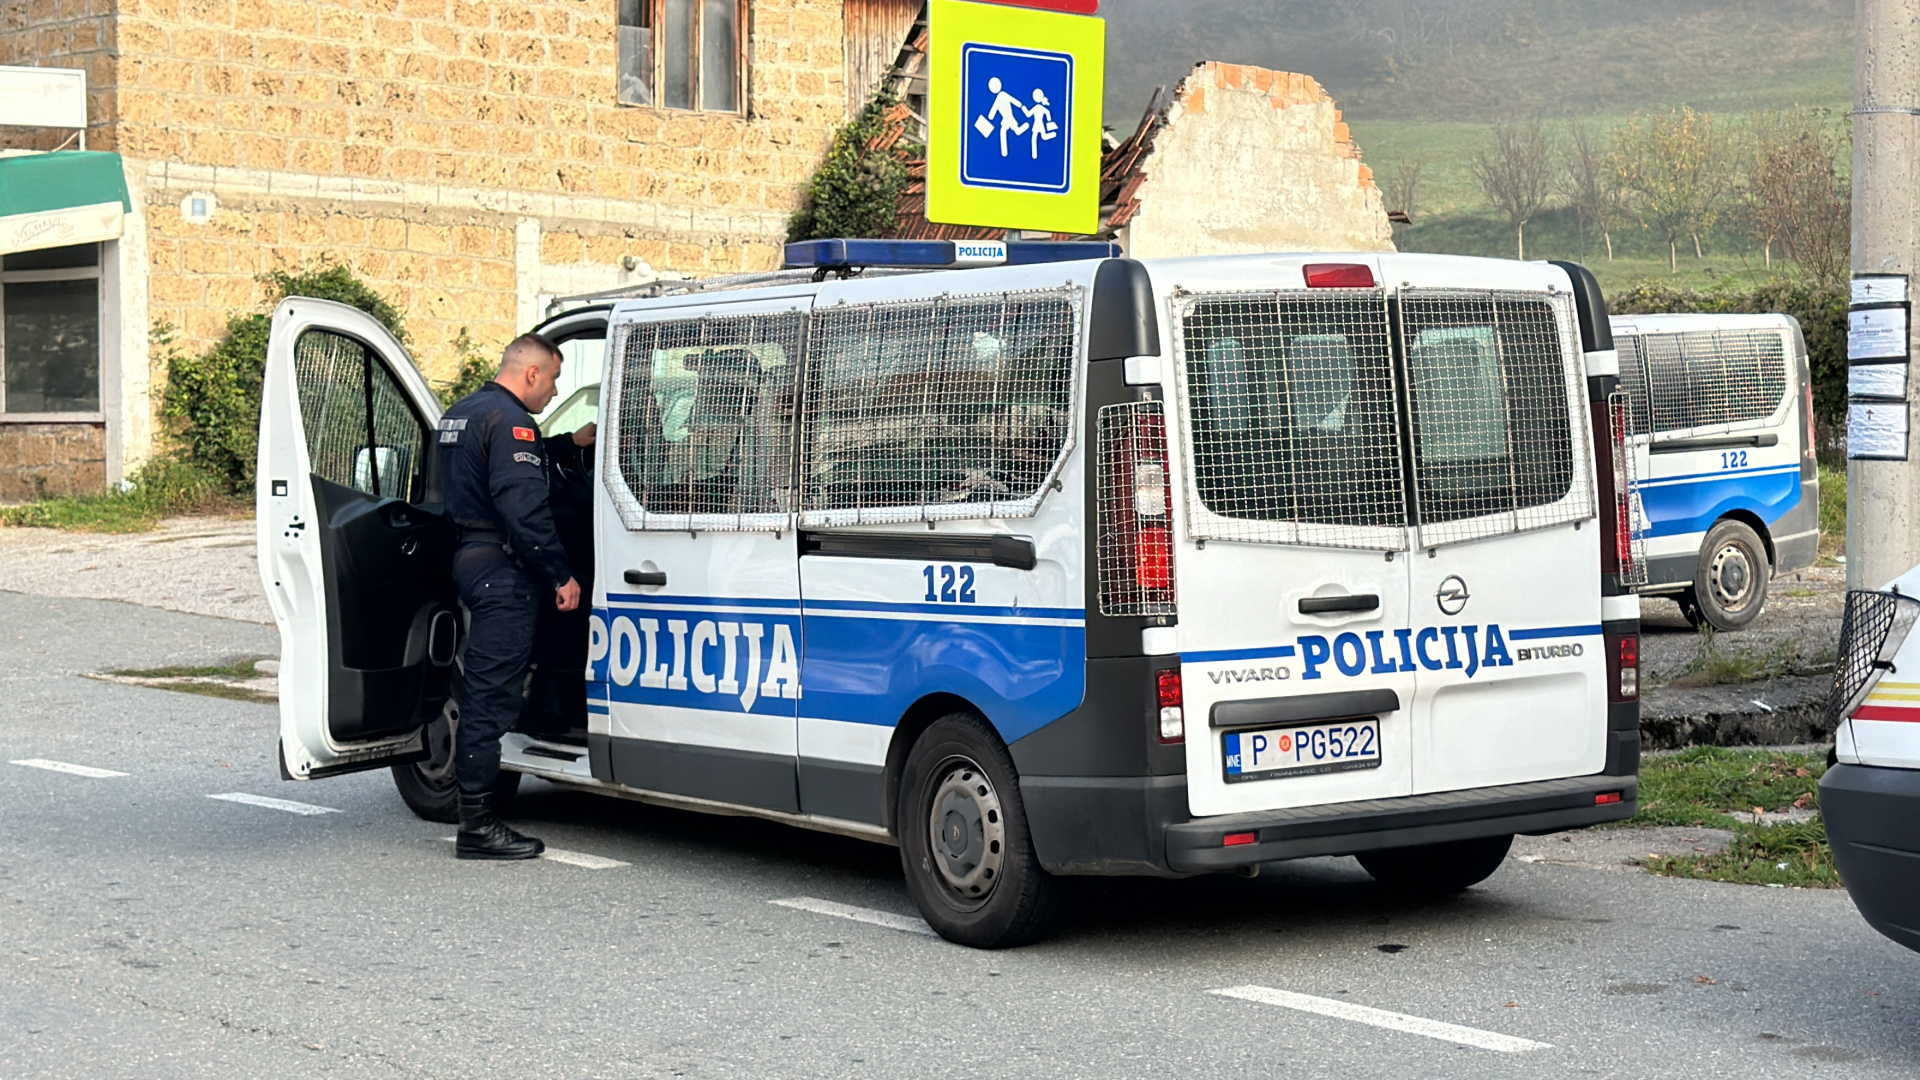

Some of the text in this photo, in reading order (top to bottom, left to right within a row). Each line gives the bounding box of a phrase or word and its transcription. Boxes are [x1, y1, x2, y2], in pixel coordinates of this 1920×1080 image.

[958, 246, 1004, 258] POLICIJA
[1721, 450, 1748, 469] 122
[923, 565, 976, 603] 122
[585, 614, 802, 713] POLICIJA
[1297, 624, 1513, 681] POLICIJA
[1517, 643, 1584, 661] BITURBO
[1207, 666, 1290, 685] VIVARO
[1252, 725, 1376, 766] P PG522
